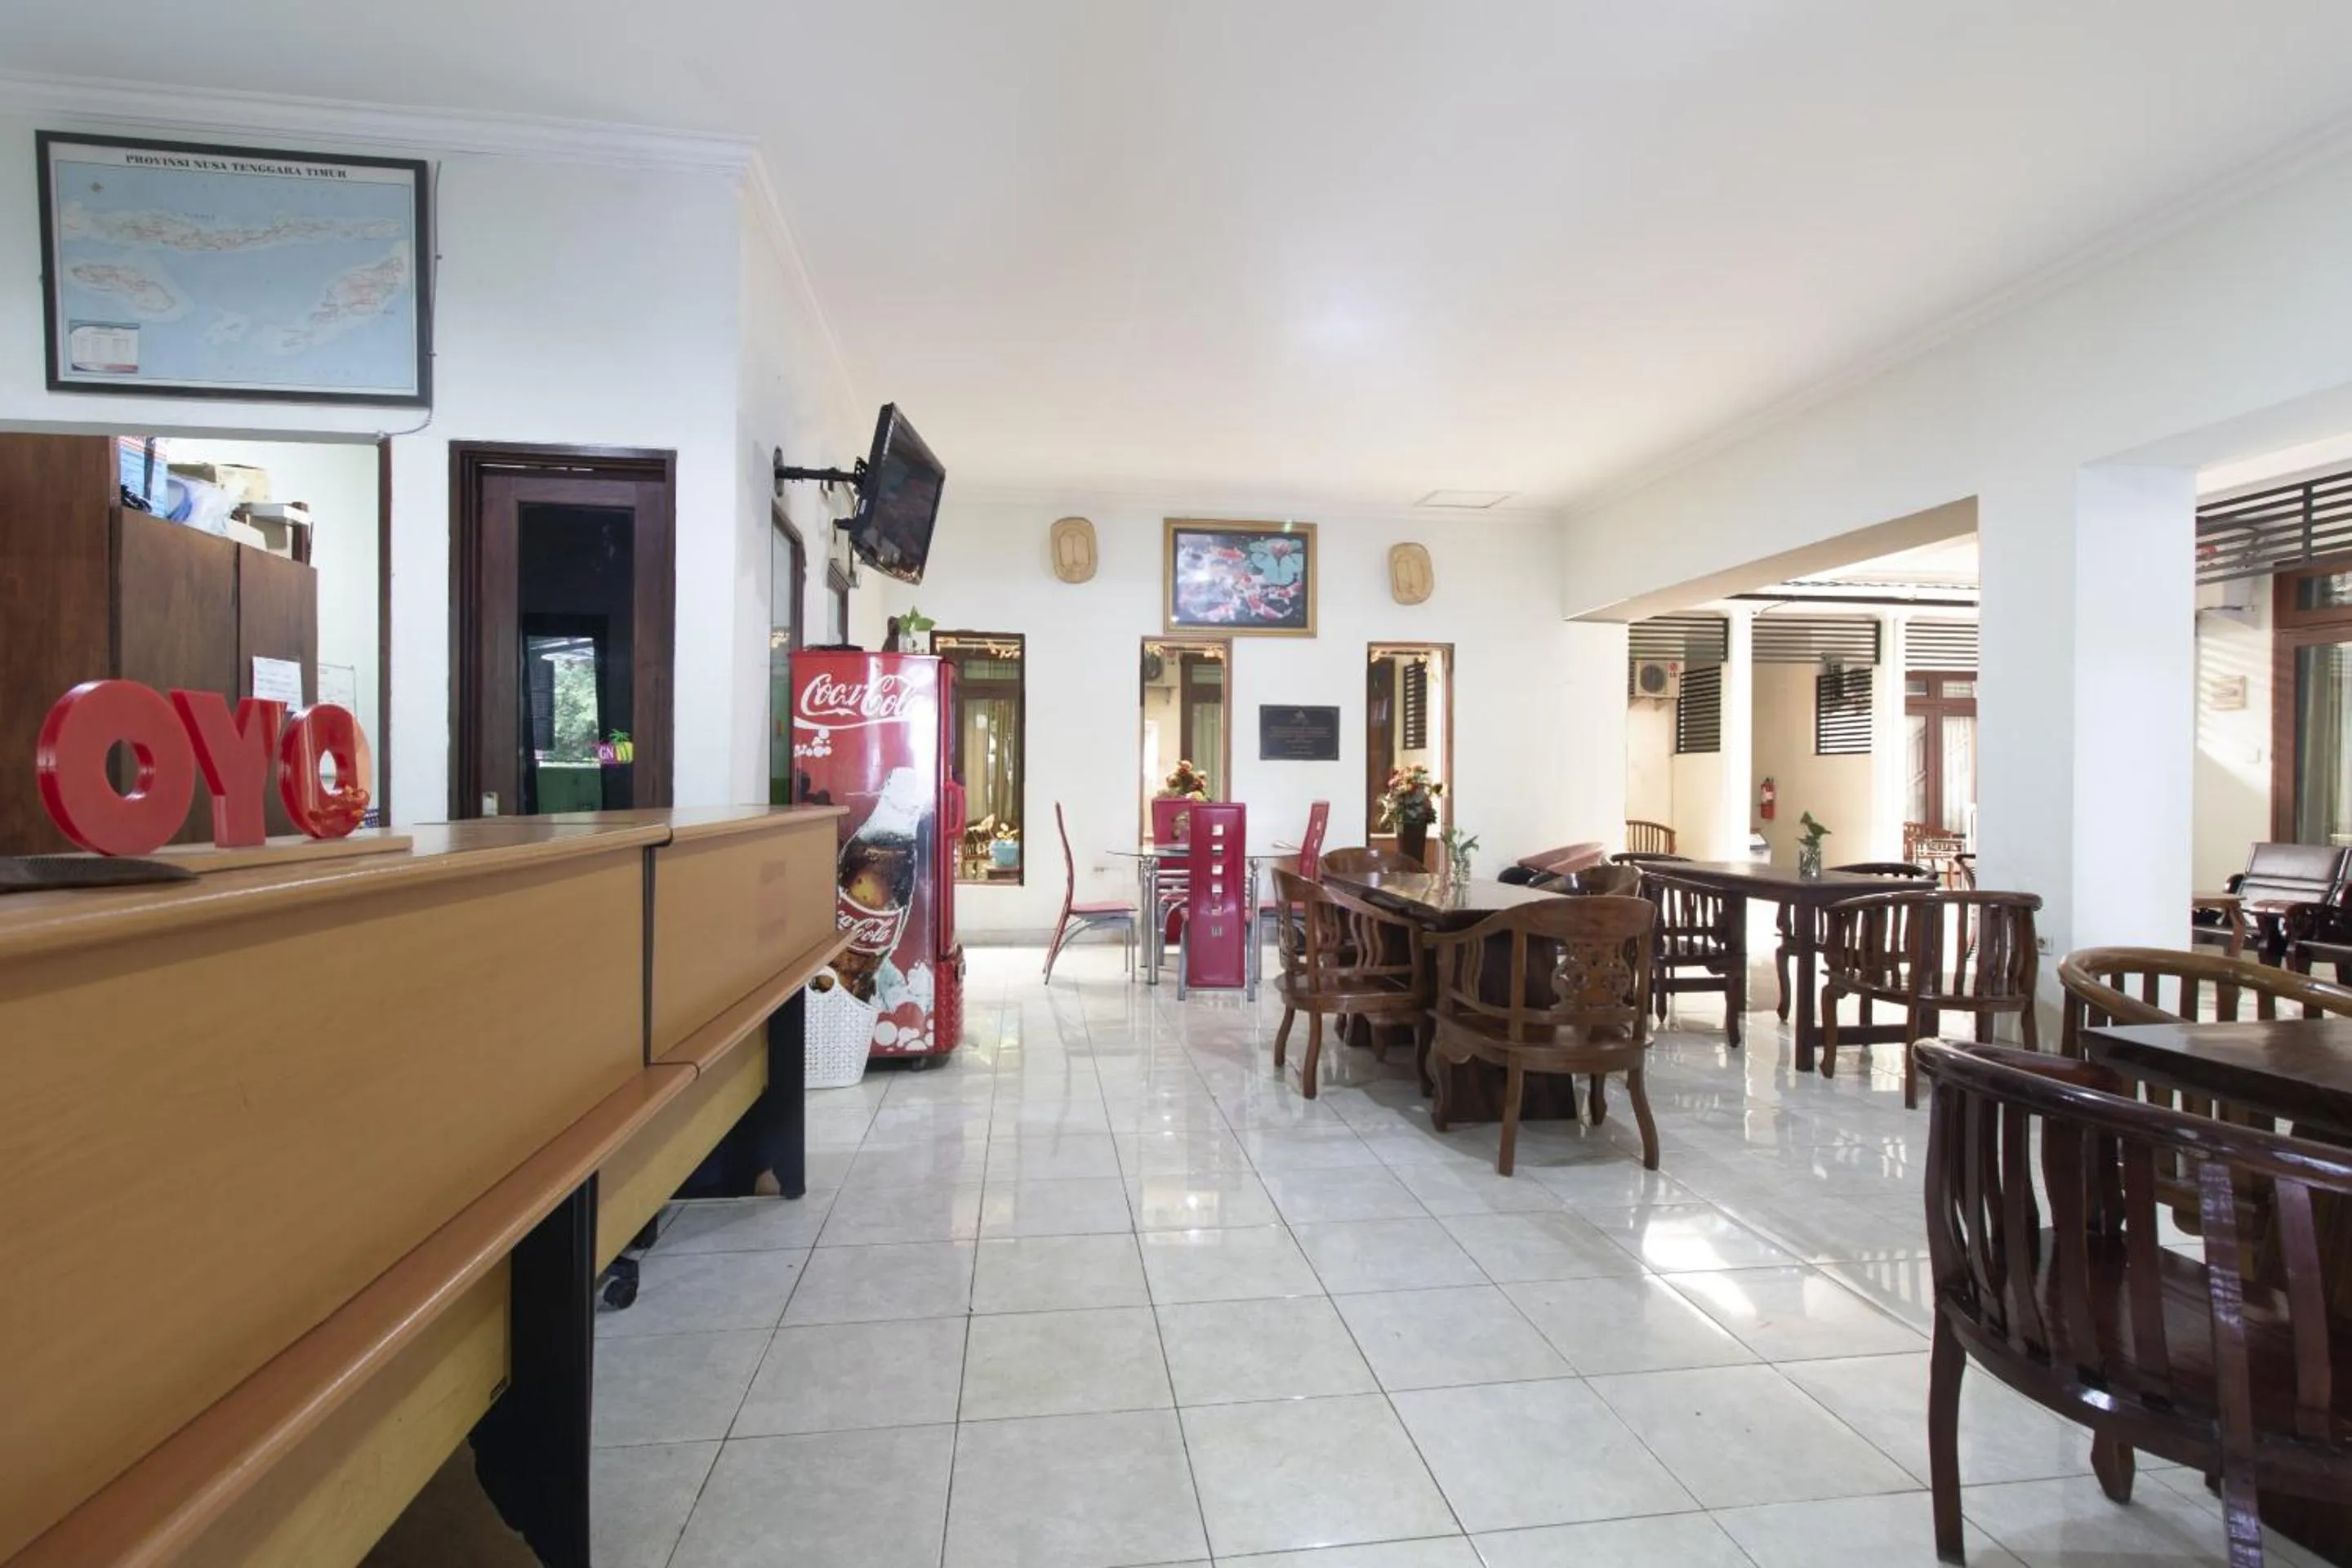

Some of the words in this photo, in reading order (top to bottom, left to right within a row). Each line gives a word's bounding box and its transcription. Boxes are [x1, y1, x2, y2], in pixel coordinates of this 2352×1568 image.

[126, 154, 189, 168] PROVINSI
[194, 160, 227, 171] NUSA
[230, 163, 302, 176] TENGGARA
[305, 167, 347, 179] TIMUR
[36, 678, 372, 856] OYO
